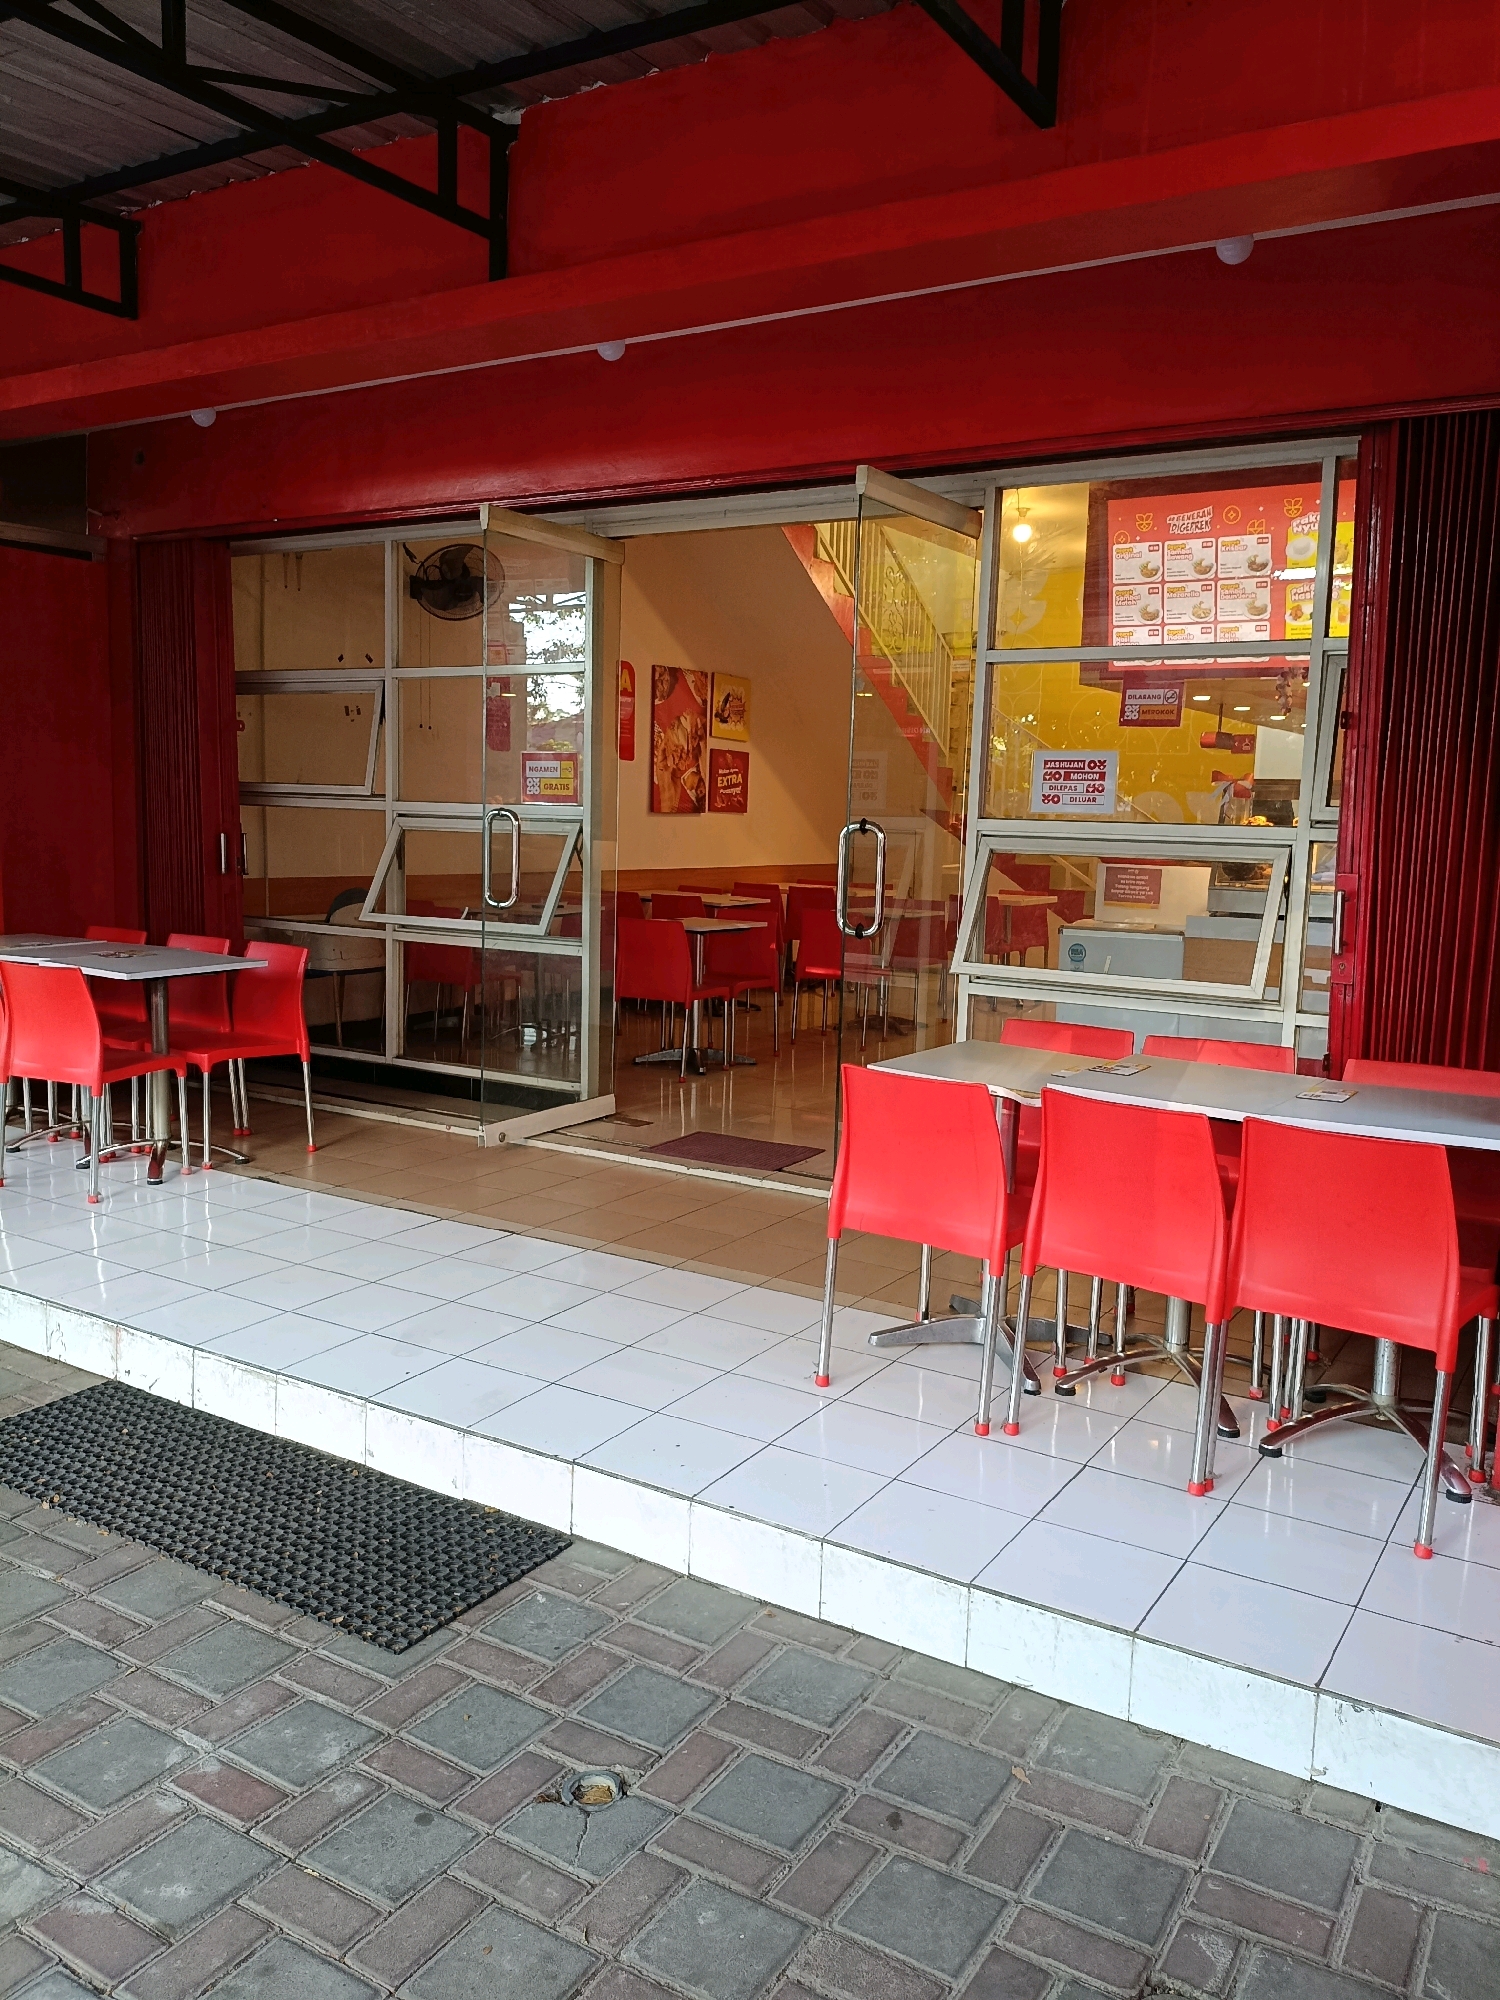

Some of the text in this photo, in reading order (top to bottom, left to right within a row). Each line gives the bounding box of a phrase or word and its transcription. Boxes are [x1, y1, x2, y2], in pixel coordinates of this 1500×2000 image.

[1115, 551, 1142, 560] Original
[1167, 632, 1194, 641] Indomie
[717, 773, 743, 787] EXTRA
[543, 783, 570, 791] GRATIS
[1048, 784, 1078, 792] DILEPAS
